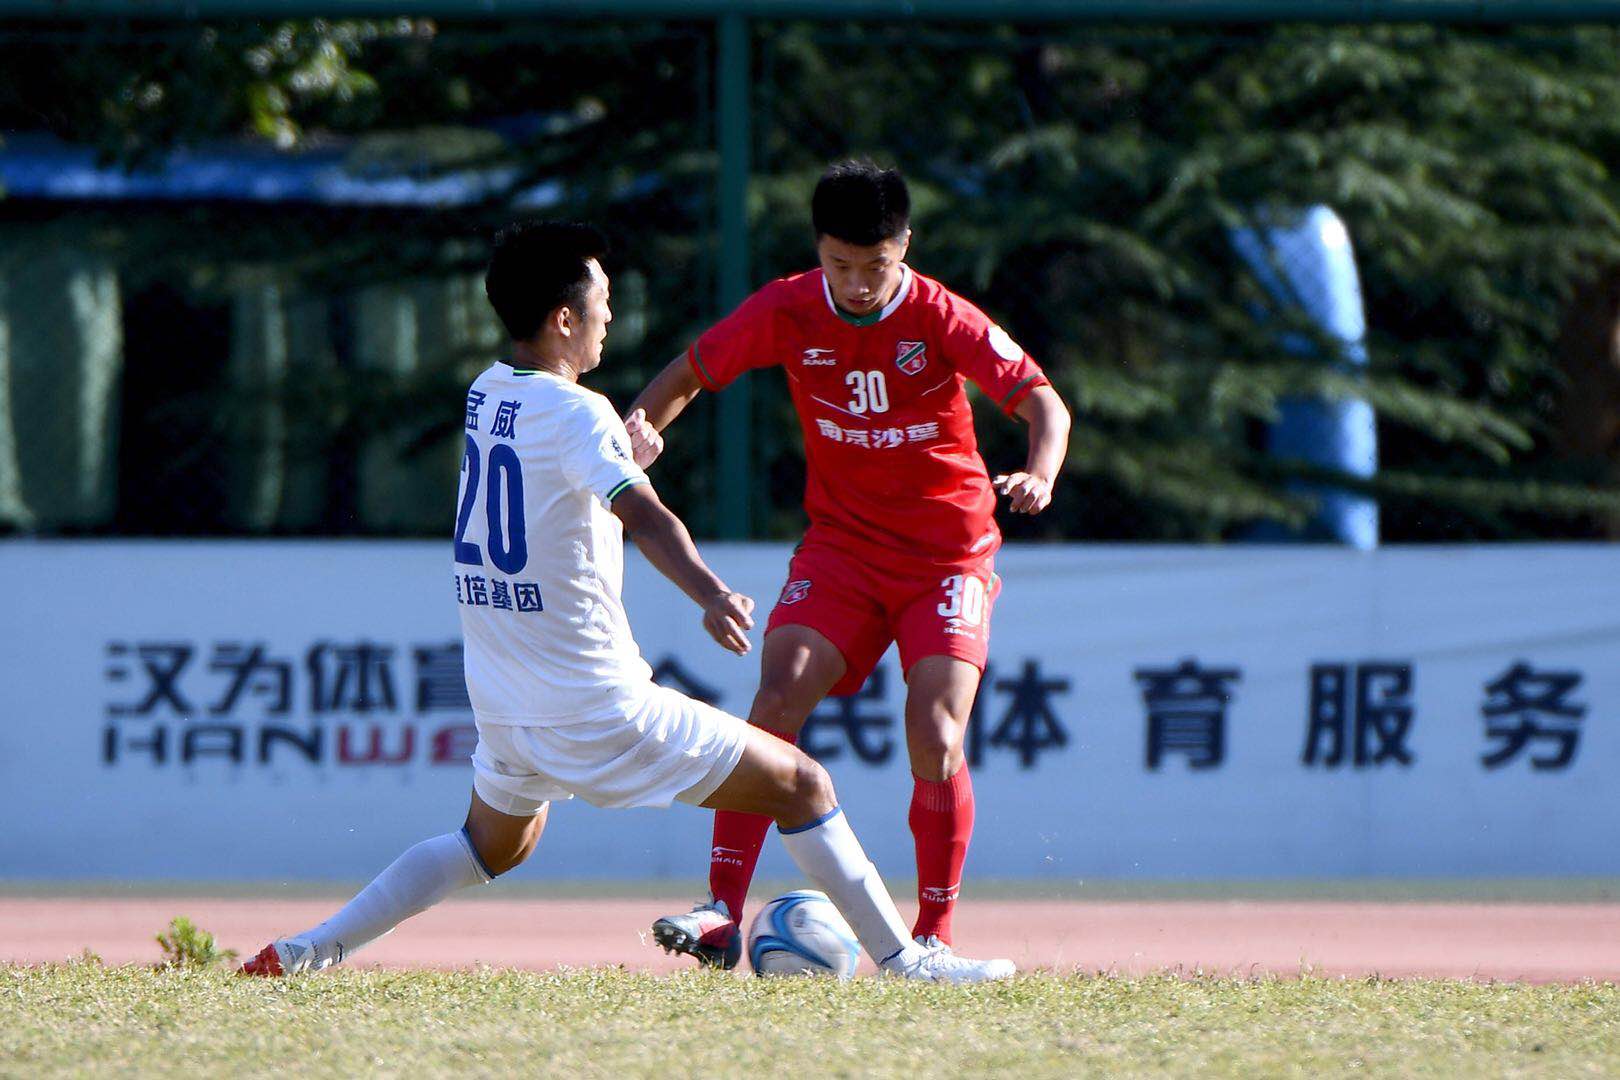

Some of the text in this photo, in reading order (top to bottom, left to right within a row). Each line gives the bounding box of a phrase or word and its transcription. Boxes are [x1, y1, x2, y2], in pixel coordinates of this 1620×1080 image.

[845, 370, 889, 413] 30
[454, 433, 528, 575] 20
[937, 575, 983, 626] 30
[711, 856, 743, 866] UNAIS
